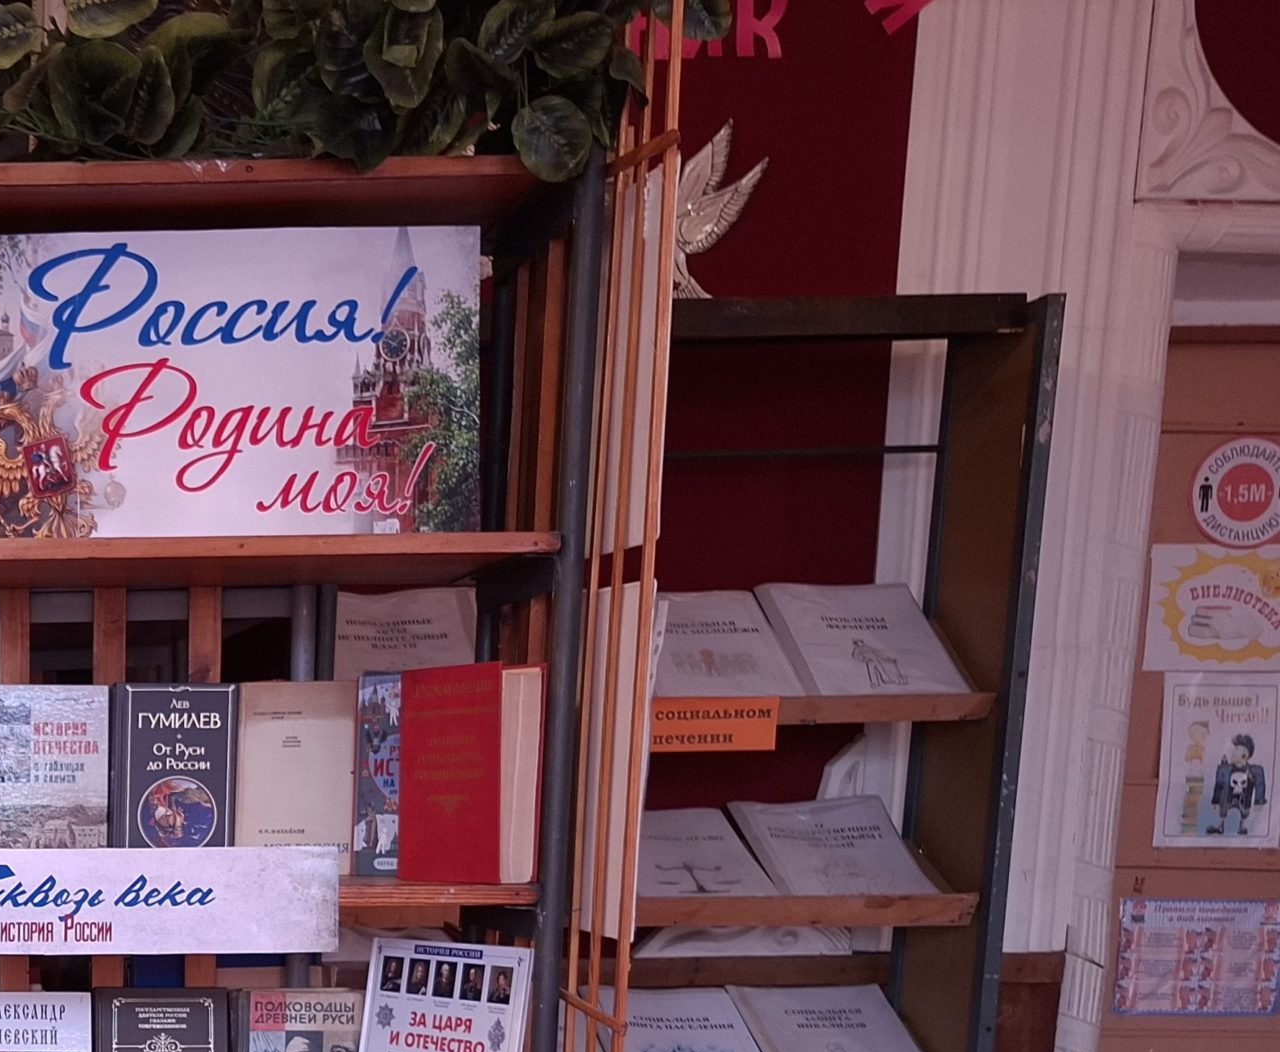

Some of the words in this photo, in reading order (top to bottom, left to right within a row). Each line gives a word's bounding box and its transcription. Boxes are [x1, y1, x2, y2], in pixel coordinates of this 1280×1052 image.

[28, 242, 418, 370] Россия!
[79, 357, 381, 493] Родина
[1208, 444, 1280, 475] СОБЛЮДАЙТЕ
[255, 441, 436, 515] моя!
[137, 712, 221, 730] ГУМИЛЕВ
[655, 708, 771, 722] социальном
[32, 722, 88, 737] ИСТОРИЯ
[32, 740, 99, 755] ОТЕЧЕСТВА
[152, 743, 172, 756] От
[175, 743, 205, 761] Руси
[146, 761, 163, 772] до
[166, 758, 211, 771] России
[113, 873, 216, 908] века
[0, 921, 54, 943] ИСТОРИЯ
[255, 1001, 355, 1013] ПОЛКОВОДЦЫ
[255, 1012, 317, 1025] ДРЕВНЕЙ
[322, 1013, 355, 1025] РУСИ
[408, 1011, 427, 1028] ЗА
[432, 1014, 473, 1034] ЦАРЯ
[389, 1031, 400, 1046] И
